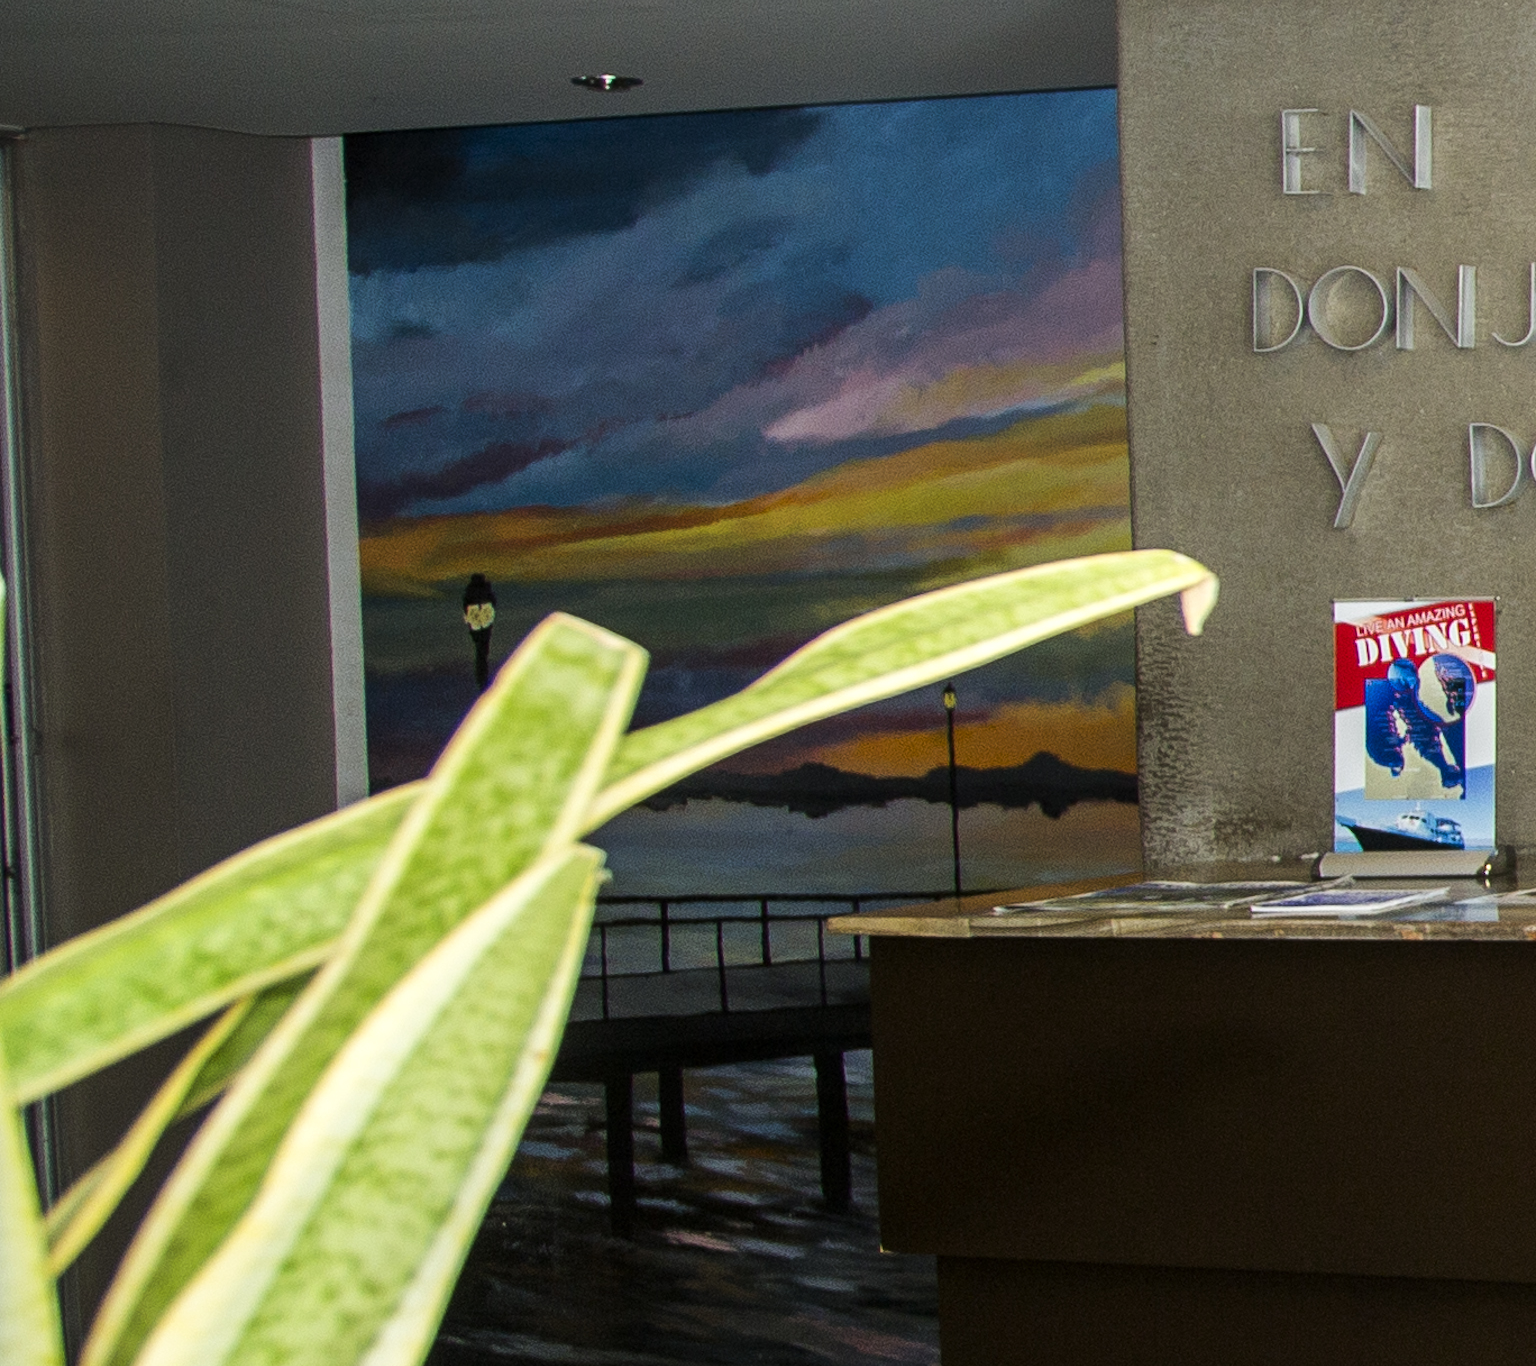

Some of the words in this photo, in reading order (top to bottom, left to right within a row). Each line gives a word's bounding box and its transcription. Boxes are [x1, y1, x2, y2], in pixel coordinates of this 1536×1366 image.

[1281, 103, 1432, 195] EN
[1253, 265, 1476, 353] DON
[1311, 422, 1384, 529] Y
[1355, 619, 1384, 638] LIVE
[1386, 615, 1406, 631] AN
[1407, 603, 1467, 628] AMAZING
[1355, 618, 1472, 667] DIVING
